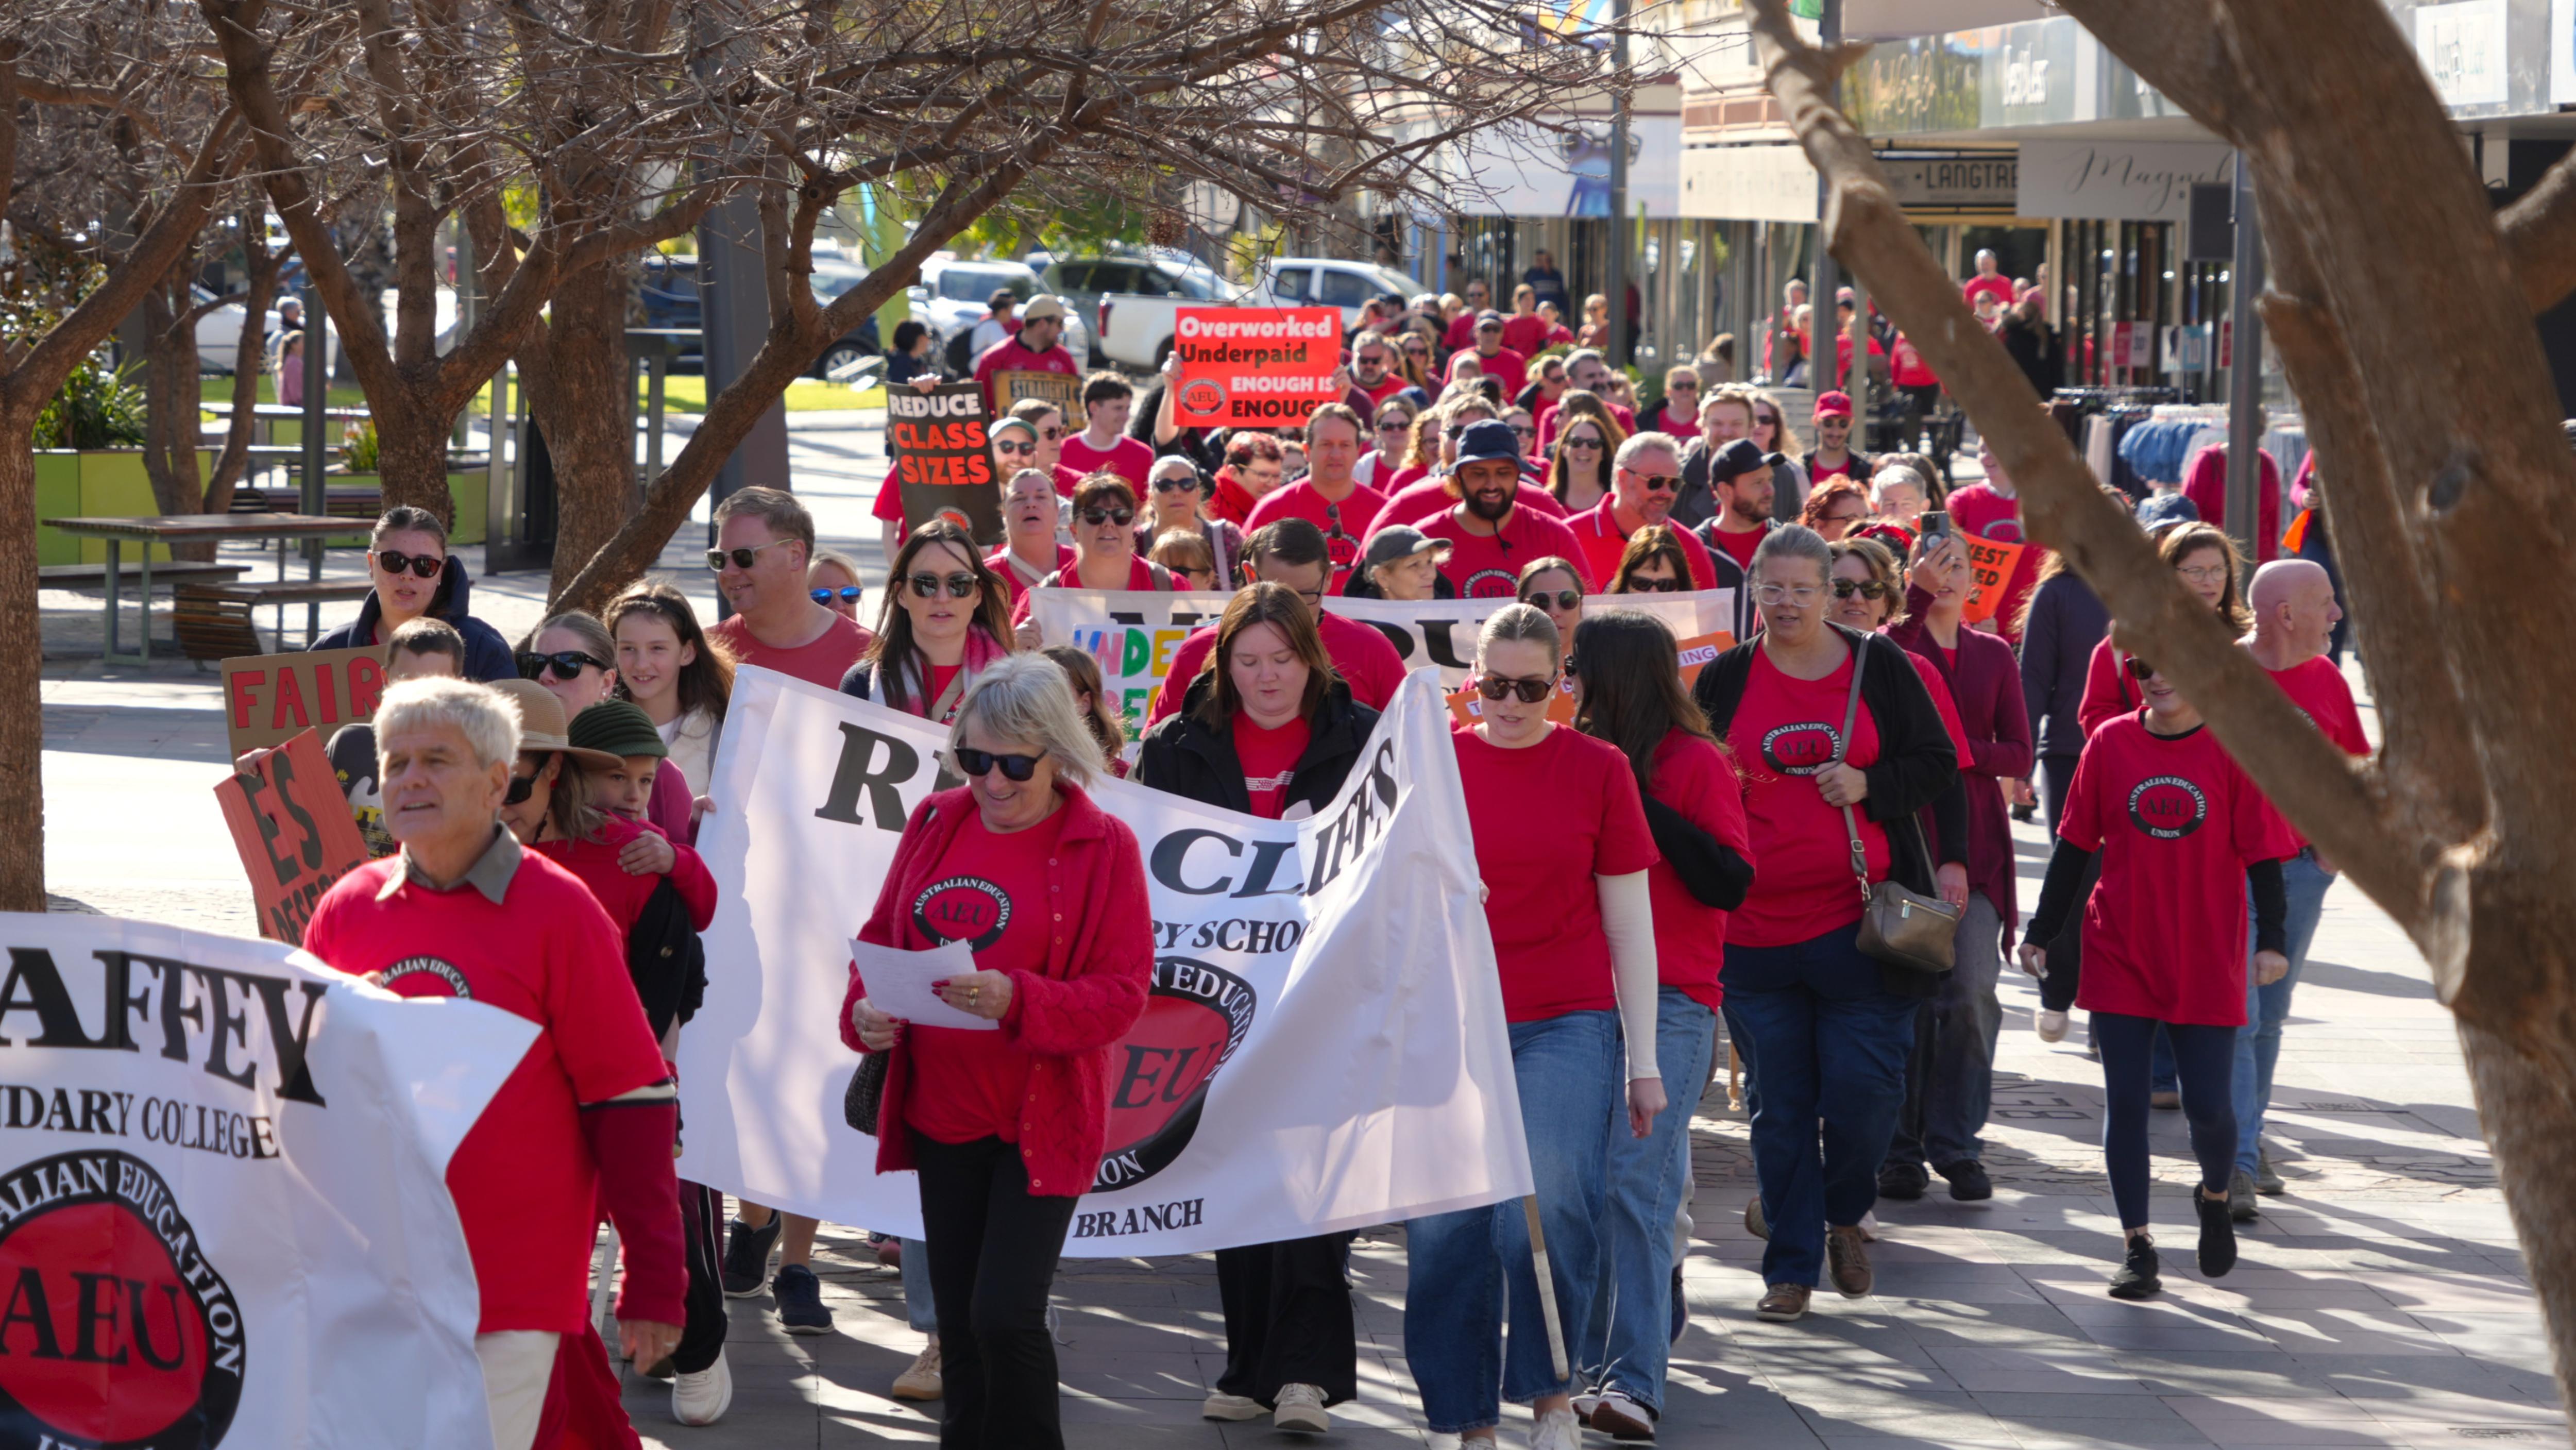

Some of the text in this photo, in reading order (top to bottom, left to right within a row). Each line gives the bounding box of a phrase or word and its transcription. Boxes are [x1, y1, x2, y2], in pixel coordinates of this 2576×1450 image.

[1179, 315, 1332, 338] Overworked
[1180, 342, 1307, 369] Underpaid
[1188, 391, 1217, 402] AEU
[1231, 376, 1309, 393] ENOUGH
[1317, 376, 1336, 392] IS
[888, 393, 981, 418] REDUCE
[1231, 399, 1334, 418] ENOUG
[894, 421, 987, 450] CLASS
[900, 454, 991, 485] SIZES
[1074, 628, 1200, 678] NDE
[230, 656, 384, 730] FAIR
[1762, 722, 1841, 759] AUSTRALIAN EDUCATION
[1778, 738, 1826, 756] AEU
[1785, 766, 1815, 774] UNION
[2128, 777, 2206, 819] AUSTRALIAN EDUCATION
[2143, 797, 2190, 817] AEU
[1150, 737, 1398, 899] CLIFFS
[2150, 828, 2180, 838] UNION
[913, 878, 1010, 930] AUSTRALIAN EDUCATION
[930, 900, 992, 926] AEU
[1170, 962, 1252, 1083] EDUCATION
[1111, 1041, 1222, 1108] EU
[141, 1096, 280, 1159] COLLEGE
[1072, 1198, 1205, 1238] BRANCH
[116, 1160, 242, 1377] EDUCATION
[0, 1267, 185, 1371] AEU
